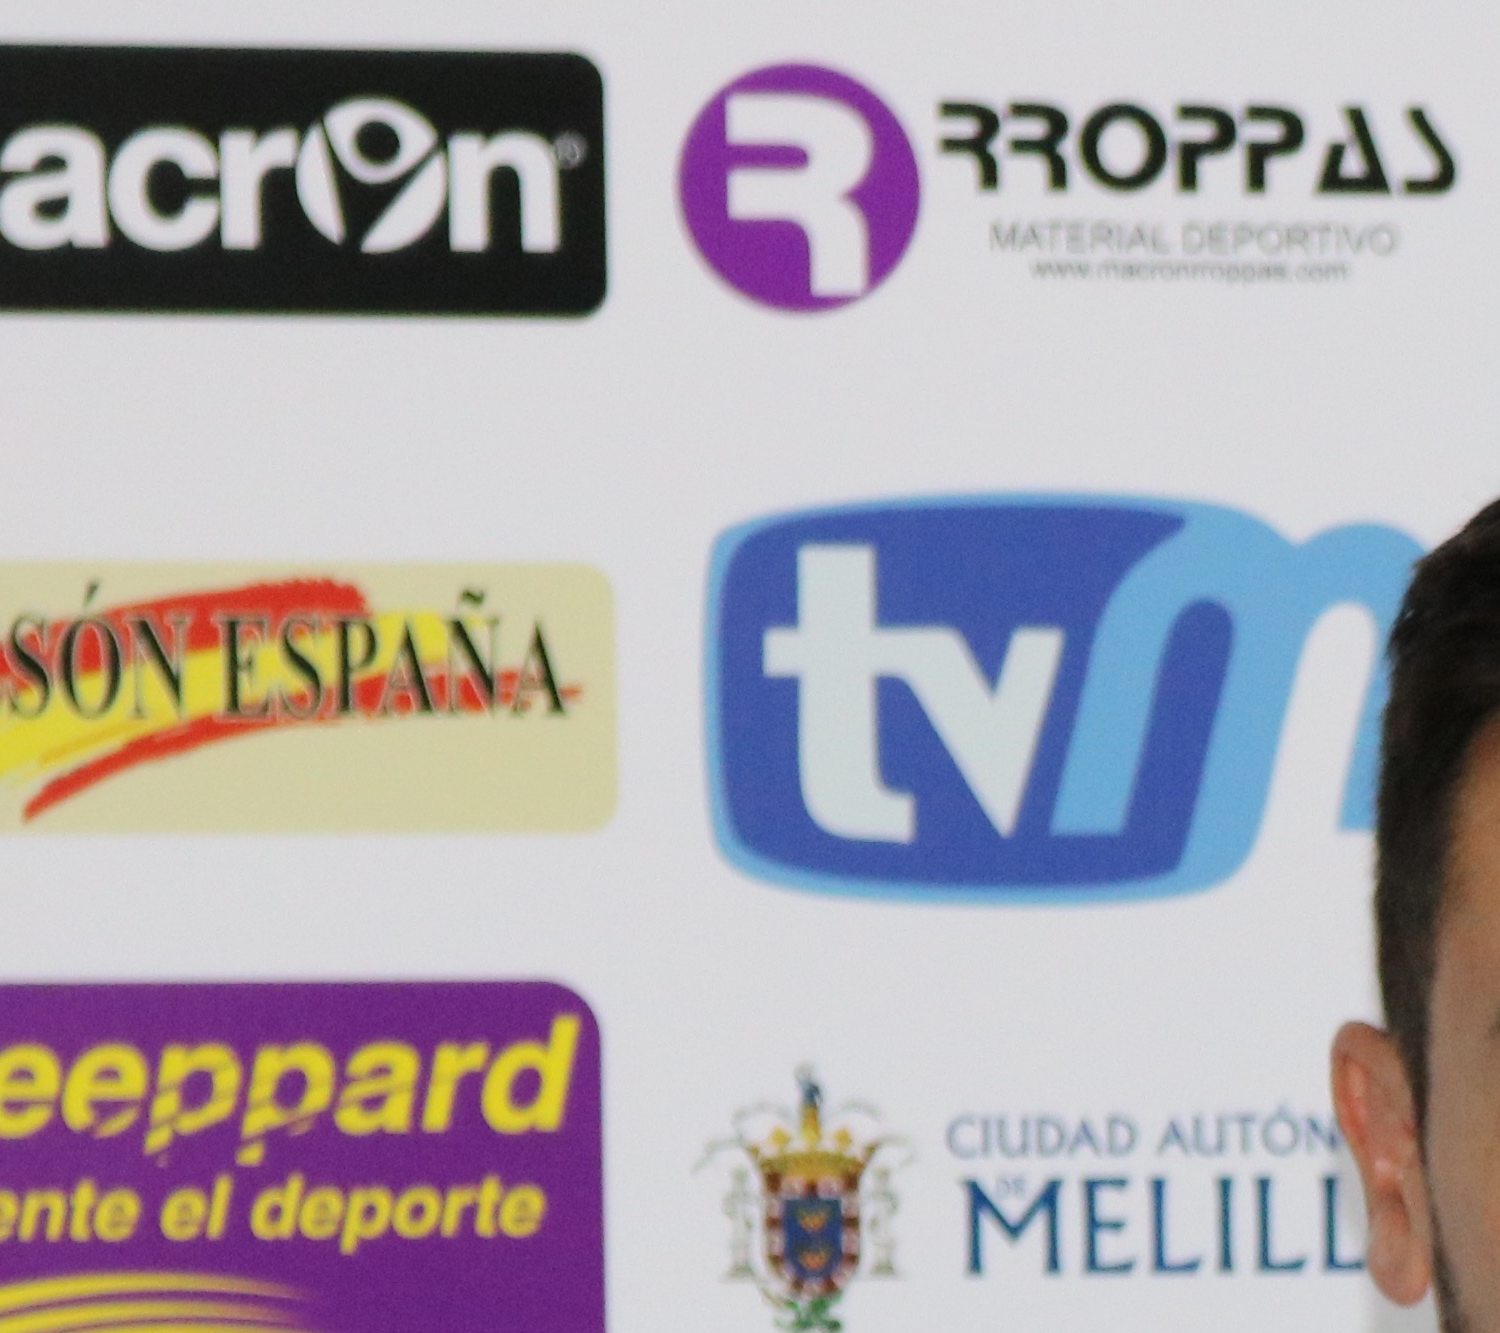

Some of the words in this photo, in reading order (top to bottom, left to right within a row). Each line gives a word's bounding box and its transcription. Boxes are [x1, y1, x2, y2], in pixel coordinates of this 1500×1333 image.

[936, 102, 1460, 194] RROPPAS
[990, 222, 1168, 254] MATERIAL
[1182, 224, 1397, 257] DEPORTIVO
[212, 588, 572, 720] ESPAÑA
[946, 1112, 1136, 1158] CIUDAD
[160, 1174, 234, 1242] el
[250, 1172, 548, 1256] deporte
